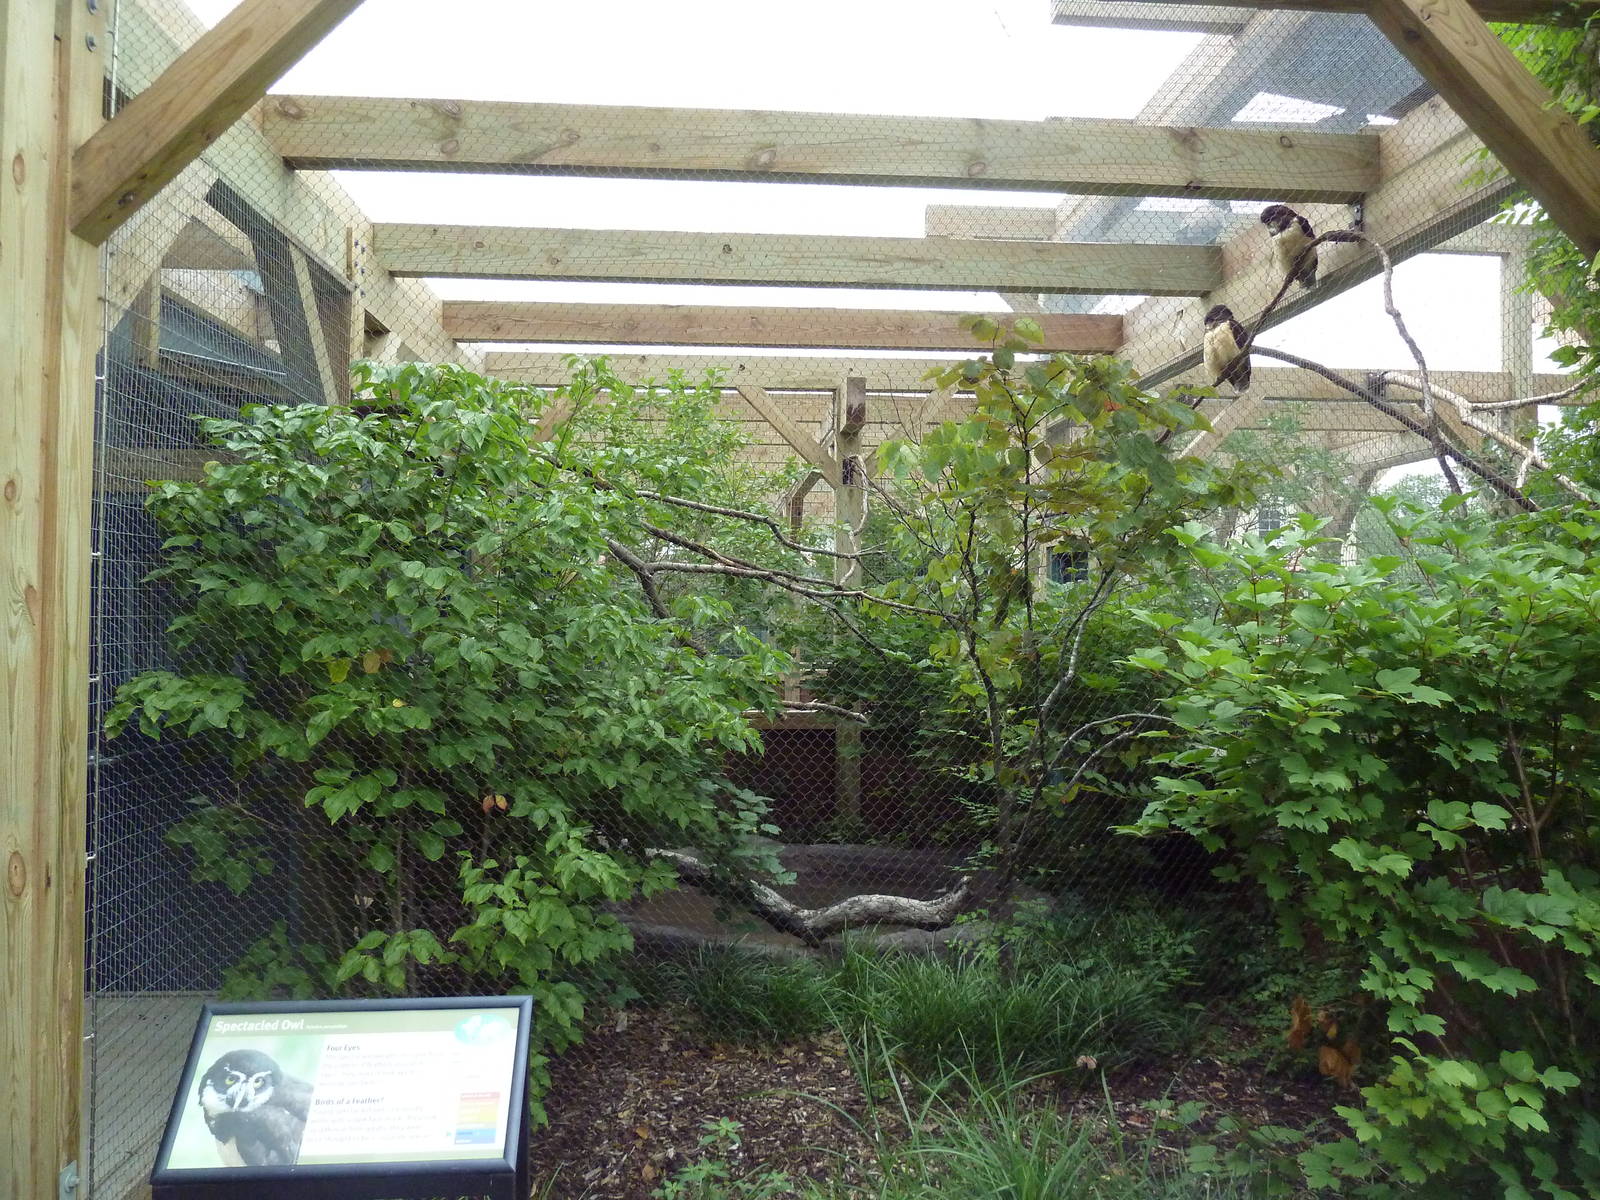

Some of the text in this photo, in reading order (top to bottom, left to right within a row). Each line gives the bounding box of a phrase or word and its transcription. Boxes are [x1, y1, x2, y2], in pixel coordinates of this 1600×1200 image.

[214, 1020, 280, 1033] Spectacled
[281, 1019, 304, 1030] Owl
[326, 1043, 361, 1052] Four Eyes
[315, 1097, 335, 1106] Birds
[336, 1097, 345, 1105] of
